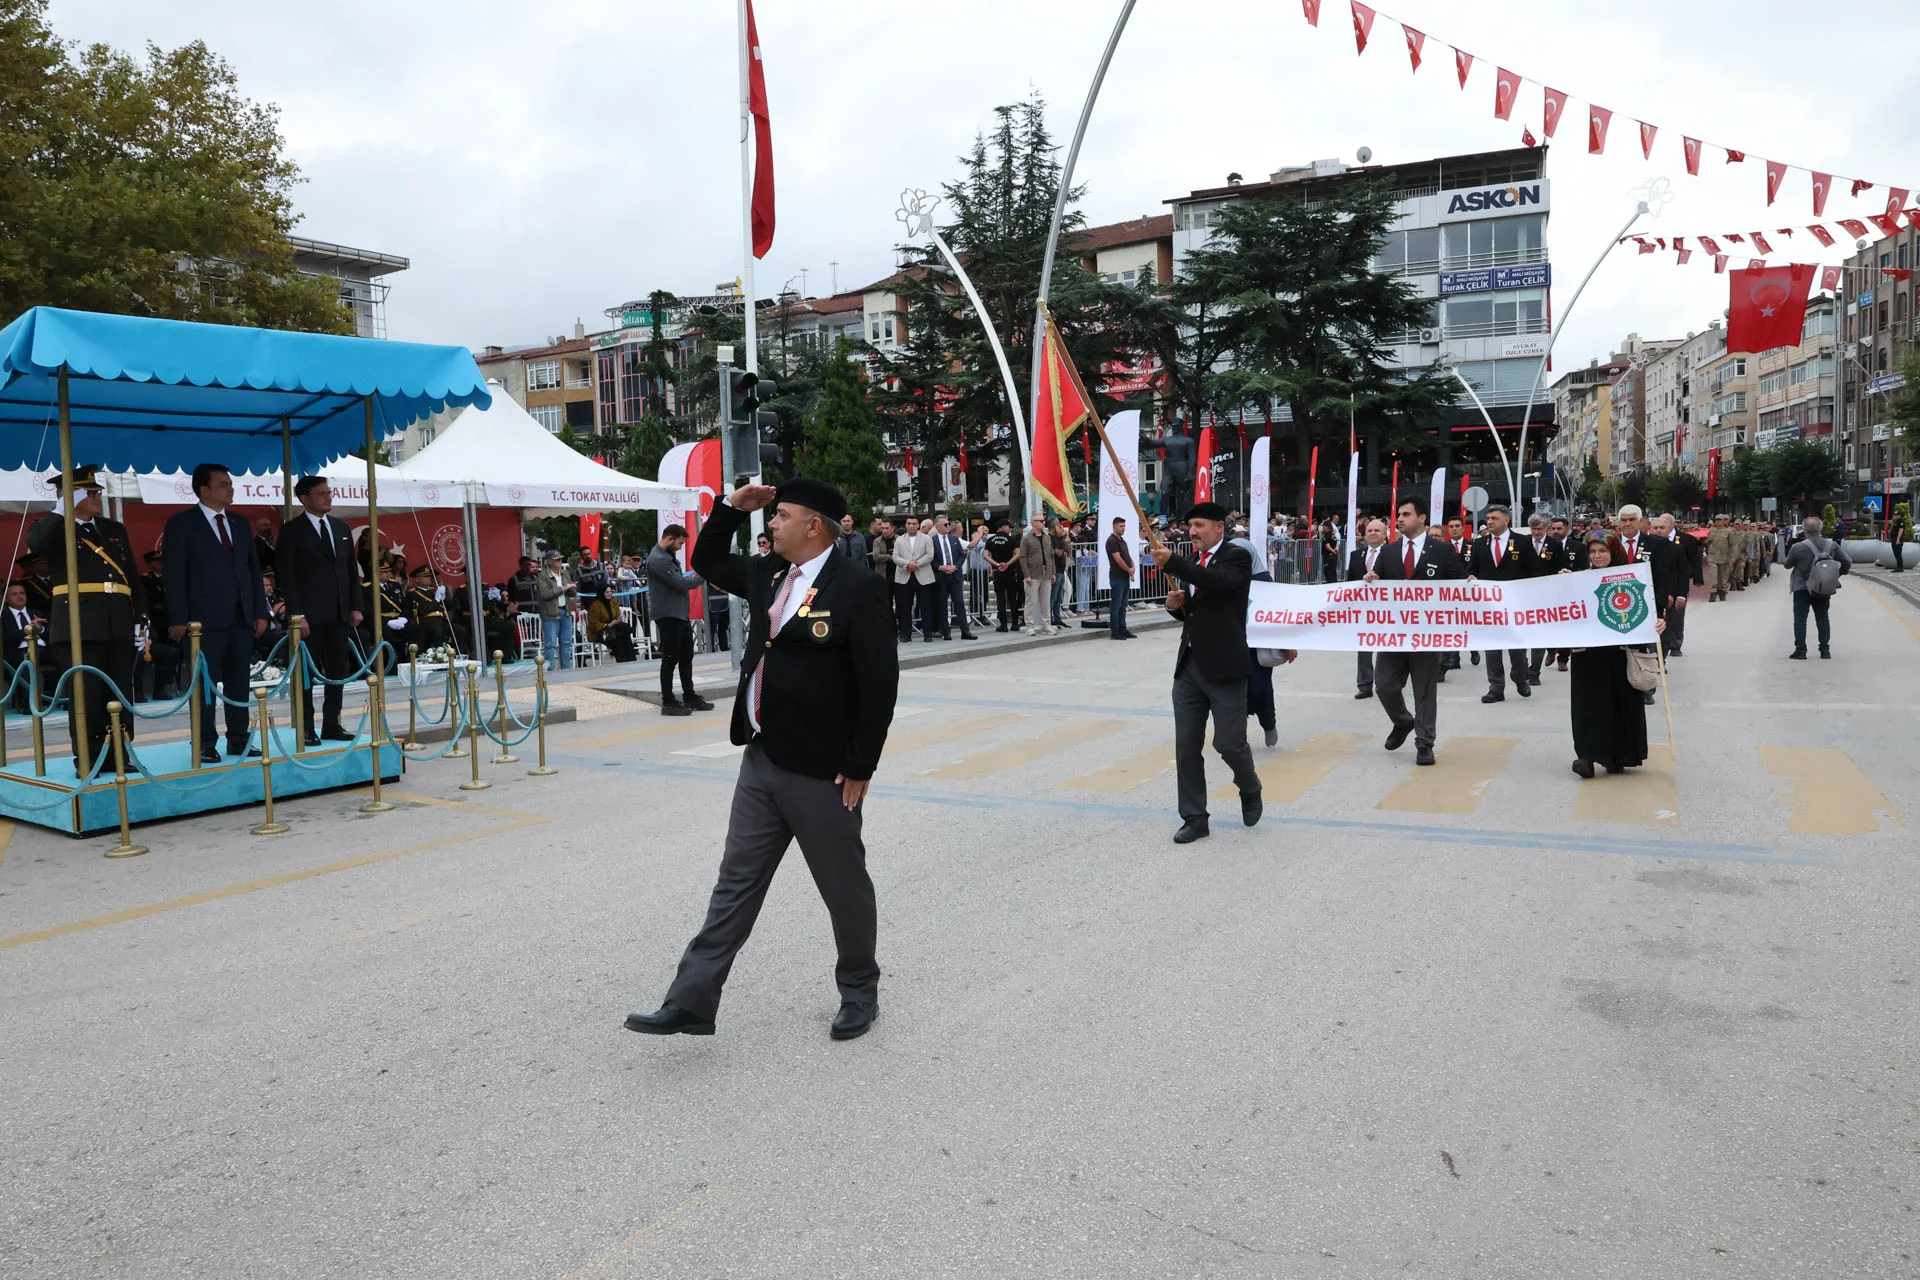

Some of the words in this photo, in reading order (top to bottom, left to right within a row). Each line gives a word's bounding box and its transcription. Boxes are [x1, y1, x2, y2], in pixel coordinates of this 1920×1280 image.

[1447, 184, 1540, 214] ASKON
[1442, 282, 1465, 292] Burak
[1465, 280, 1489, 291] ÇELİK
[1497, 279, 1521, 287] Turan
[1522, 274, 1546, 286] ÇELİK
[243, 485, 270, 497] T.C.
[551, 490, 569, 501] T.C.
[570, 491, 600, 502] TOKAT
[602, 491, 640, 503] VALİLİĞİ
[1326, 584, 1388, 603] TÜRKİYE
[1393, 587, 1434, 602] HARP
[1439, 584, 1503, 602] MALÜLÜ
[1254, 608, 1314, 625] GAZİLER
[1317, 607, 1361, 627] ŞEHİT
[1366, 610, 1396, 625] DUL
[1400, 610, 1420, 625] VE
[1424, 607, 1509, 626] YETİMLERİ
[1514, 600, 1588, 626] DERNEĞİ
[1357, 632, 1406, 647] TOKAT
[1411, 630, 1469, 650] ŞUBESİ
